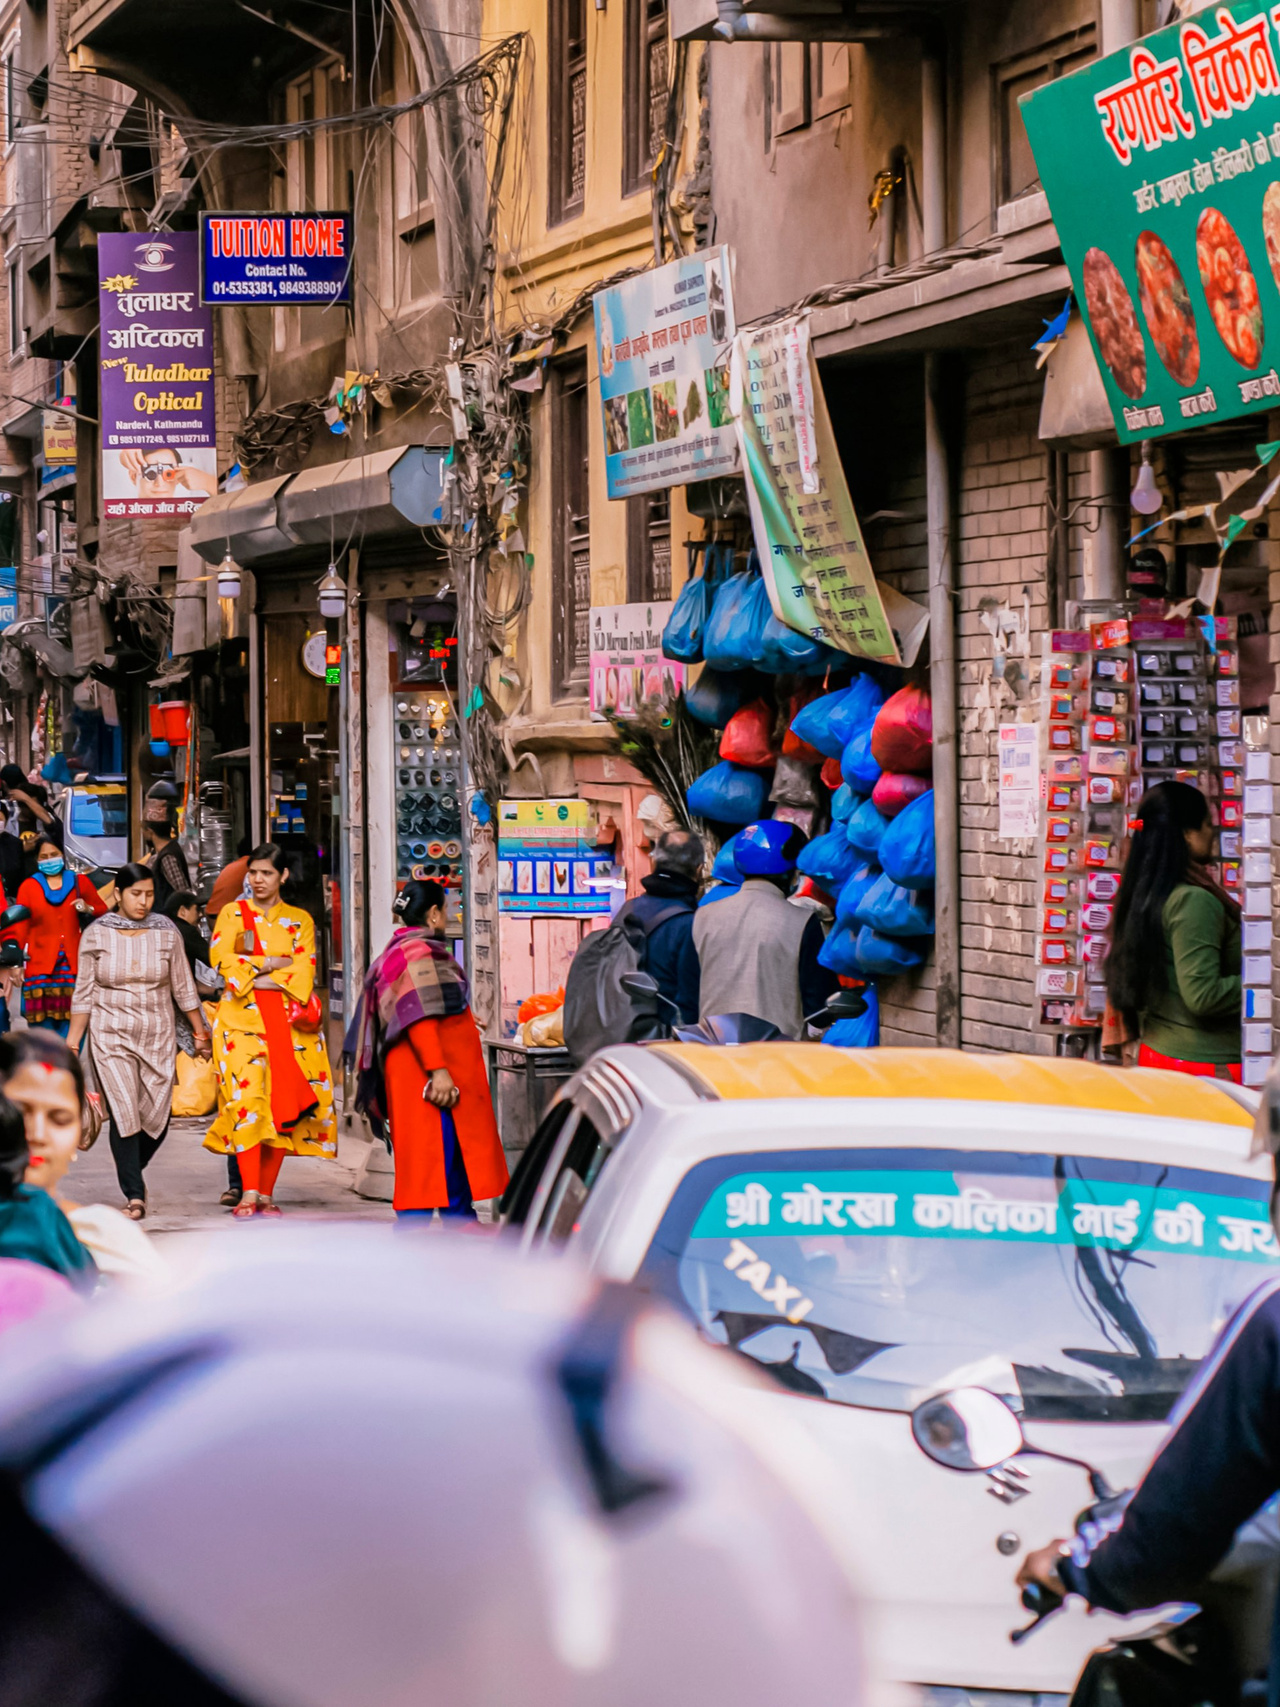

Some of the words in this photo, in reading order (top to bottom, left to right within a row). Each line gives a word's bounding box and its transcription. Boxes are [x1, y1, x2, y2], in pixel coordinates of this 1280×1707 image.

[209, 219, 285, 257] TUITION
[291, 219, 344, 257] HOME
[245, 263, 287, 277] Contact
[289, 264, 307, 277] No.
[213, 281, 277, 297] 01-5353381,
[117, 292, 194, 318] तुलाधर
[107, 323, 205, 349] अप्टिकल
[101, 356, 128, 370] New
[123, 363, 212, 383] Tuladhar
[133, 392, 203, 415] Optical
[116, 421, 152, 430] Nardevi,
[154, 420, 203, 430] Kathmandu
[725, 1182, 772, 1229] श्री
[781, 1183, 898, 1229] गोरखा
[913, 1187, 1058, 1234] कालिका
[1073, 1198, 1141, 1245] माई
[1154, 1202, 1206, 1247] की
[723, 1238, 814, 1324] TAXI
